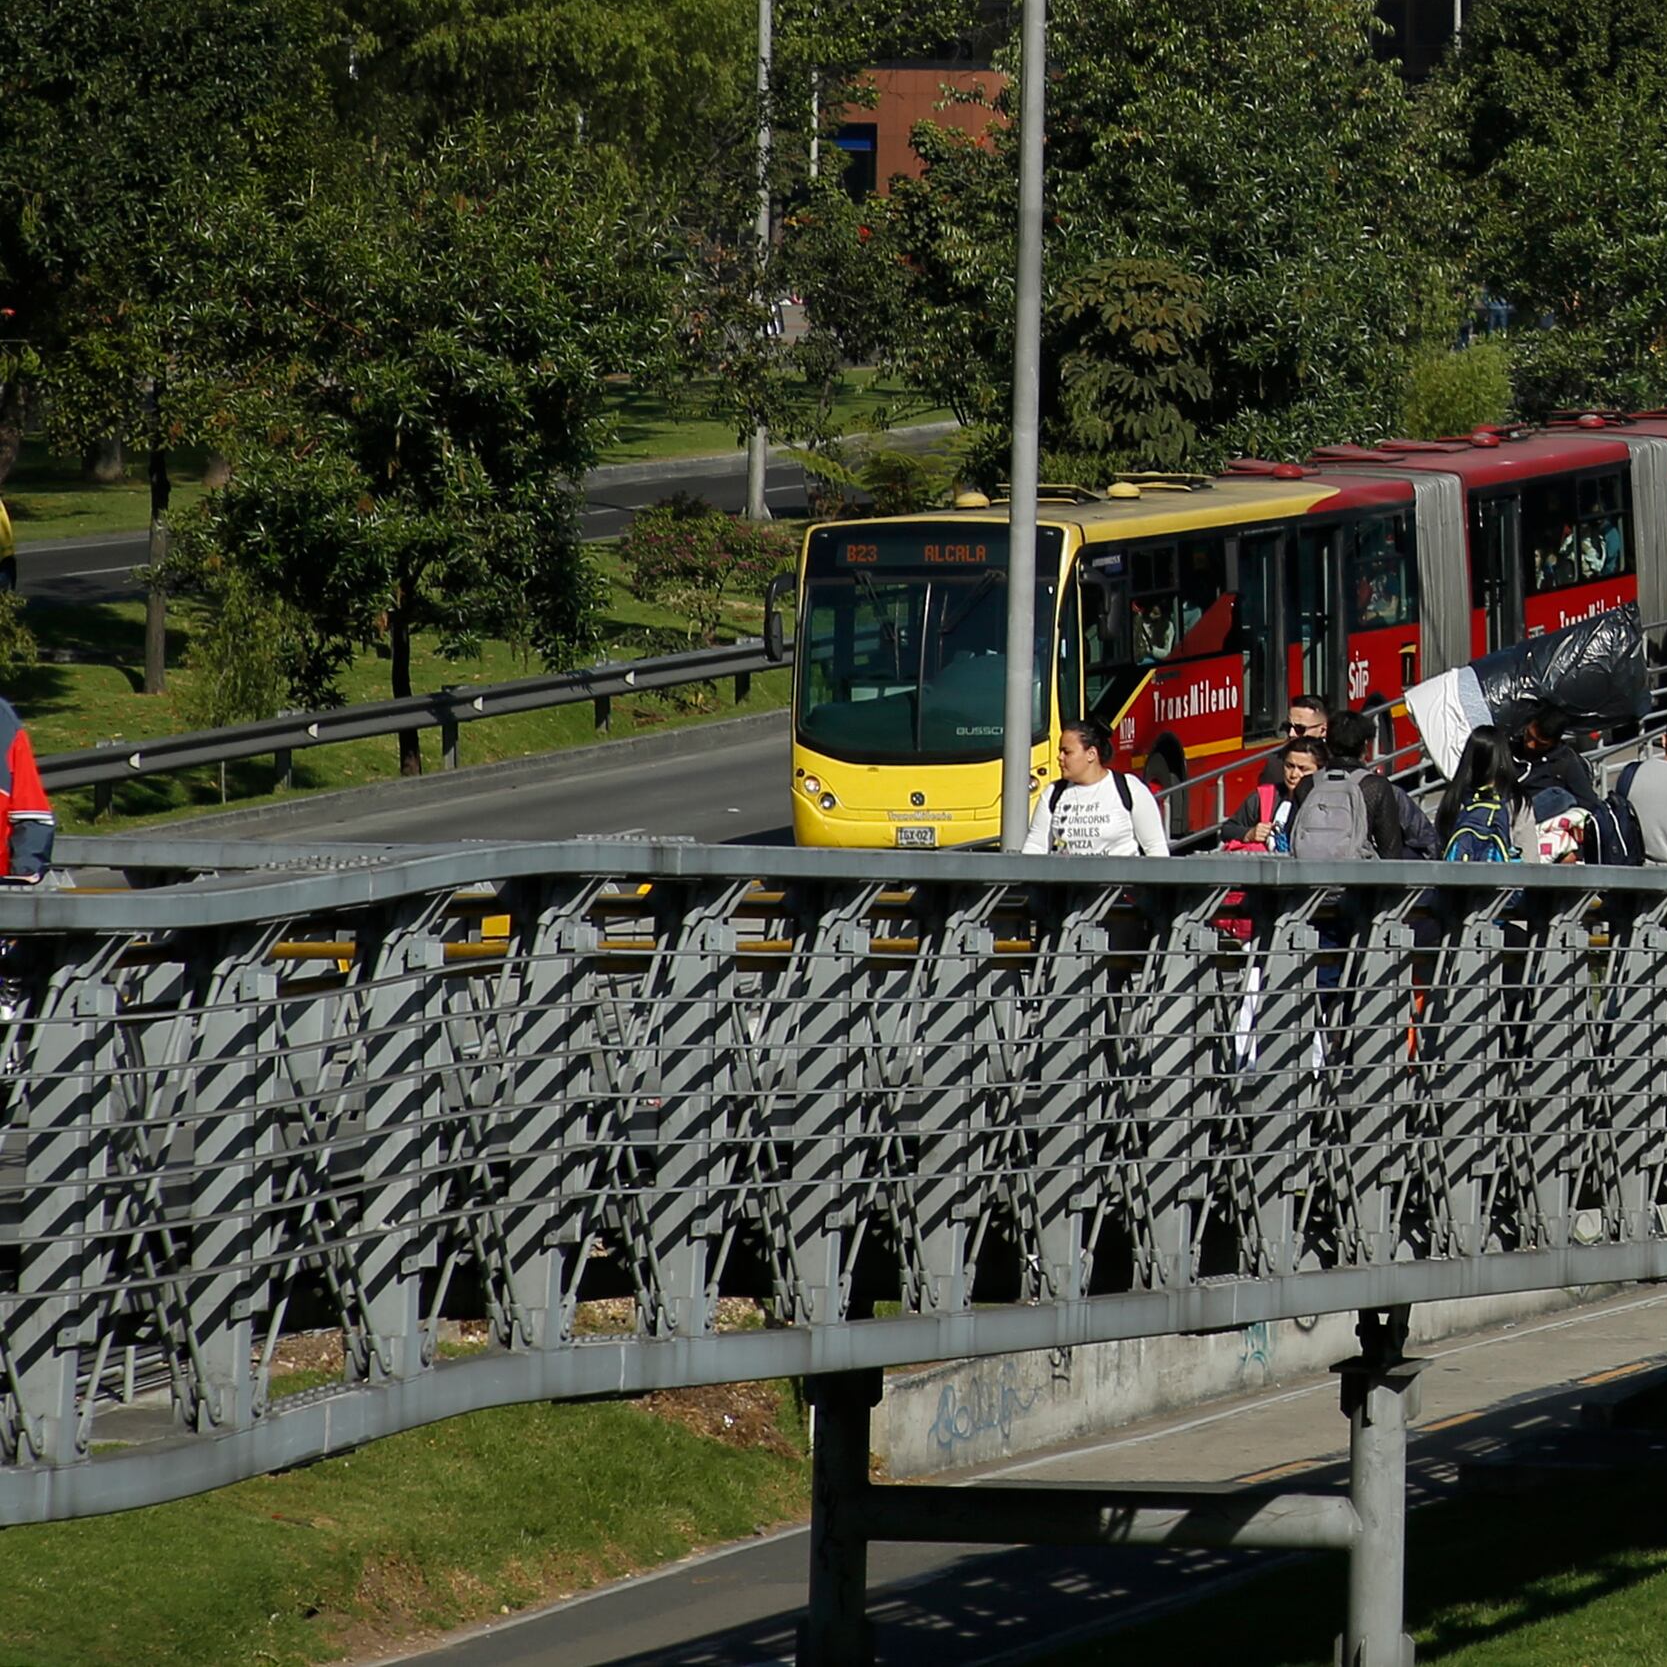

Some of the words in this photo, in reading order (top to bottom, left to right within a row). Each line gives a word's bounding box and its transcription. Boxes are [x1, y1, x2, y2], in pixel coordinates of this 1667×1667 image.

[846, 544, 878, 562] B23
[924, 544, 986, 562] ALCALA
[1153, 676, 1239, 723] TransMilenio
[1068, 814, 1111, 825] UNICORNS
[1067, 827, 1101, 838] SMILES
